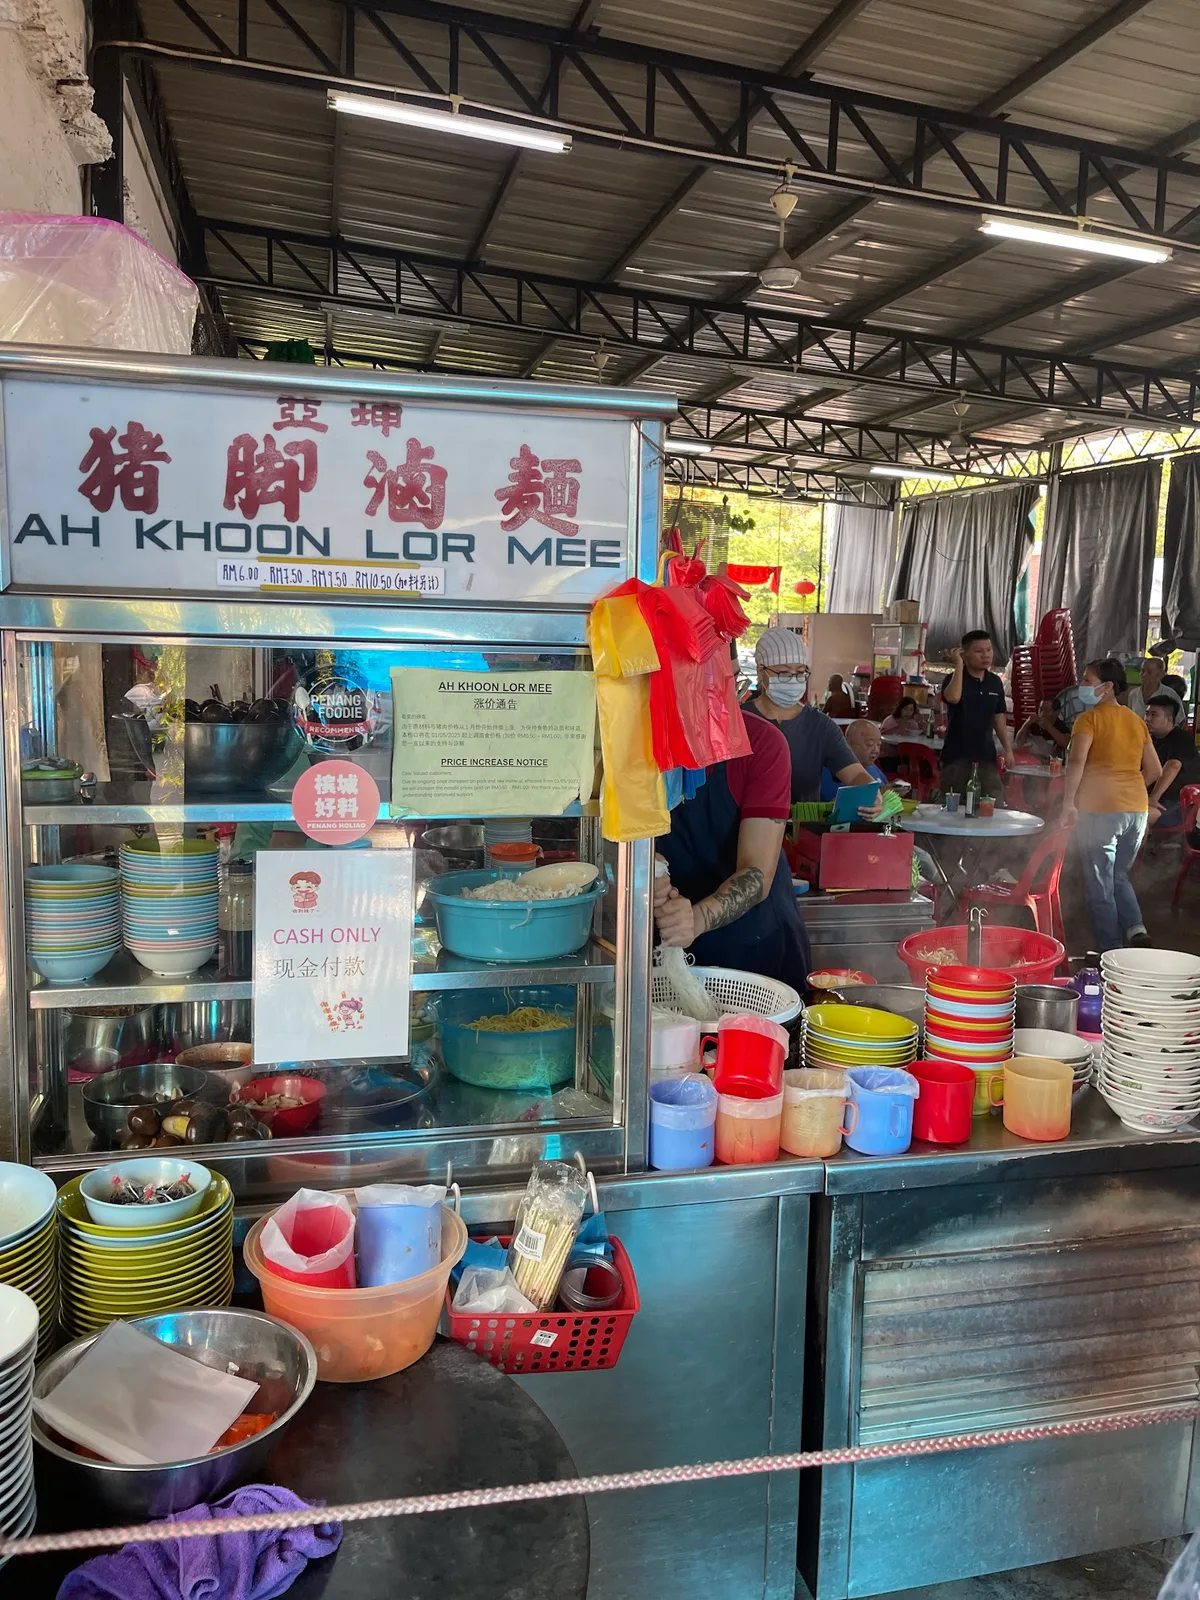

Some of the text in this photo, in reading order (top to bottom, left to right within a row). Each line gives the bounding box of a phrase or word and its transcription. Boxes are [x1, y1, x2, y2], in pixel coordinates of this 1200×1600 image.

[12, 513, 622, 568] AH KHOON LOR MEE
[222, 564, 259, 582] RM6.00
[269, 566, 303, 586] RM7.50
[311, 570, 347, 588] RM9.50
[355, 573, 392, 591] RM10.50
[438, 682, 553, 693] AH KHOON LOR MEE
[311, 694, 361, 707] PENANG
[473, 698, 518, 710] 涨价通告
[318, 706, 363, 719] FOODIE
[309, 725, 365, 734] RECOMMENDS
[441, 758, 548, 767] PRICE INCREASE NOTICE
[273, 927, 381, 945] CASH ONLY
[273, 956, 365, 979] 现金付款
